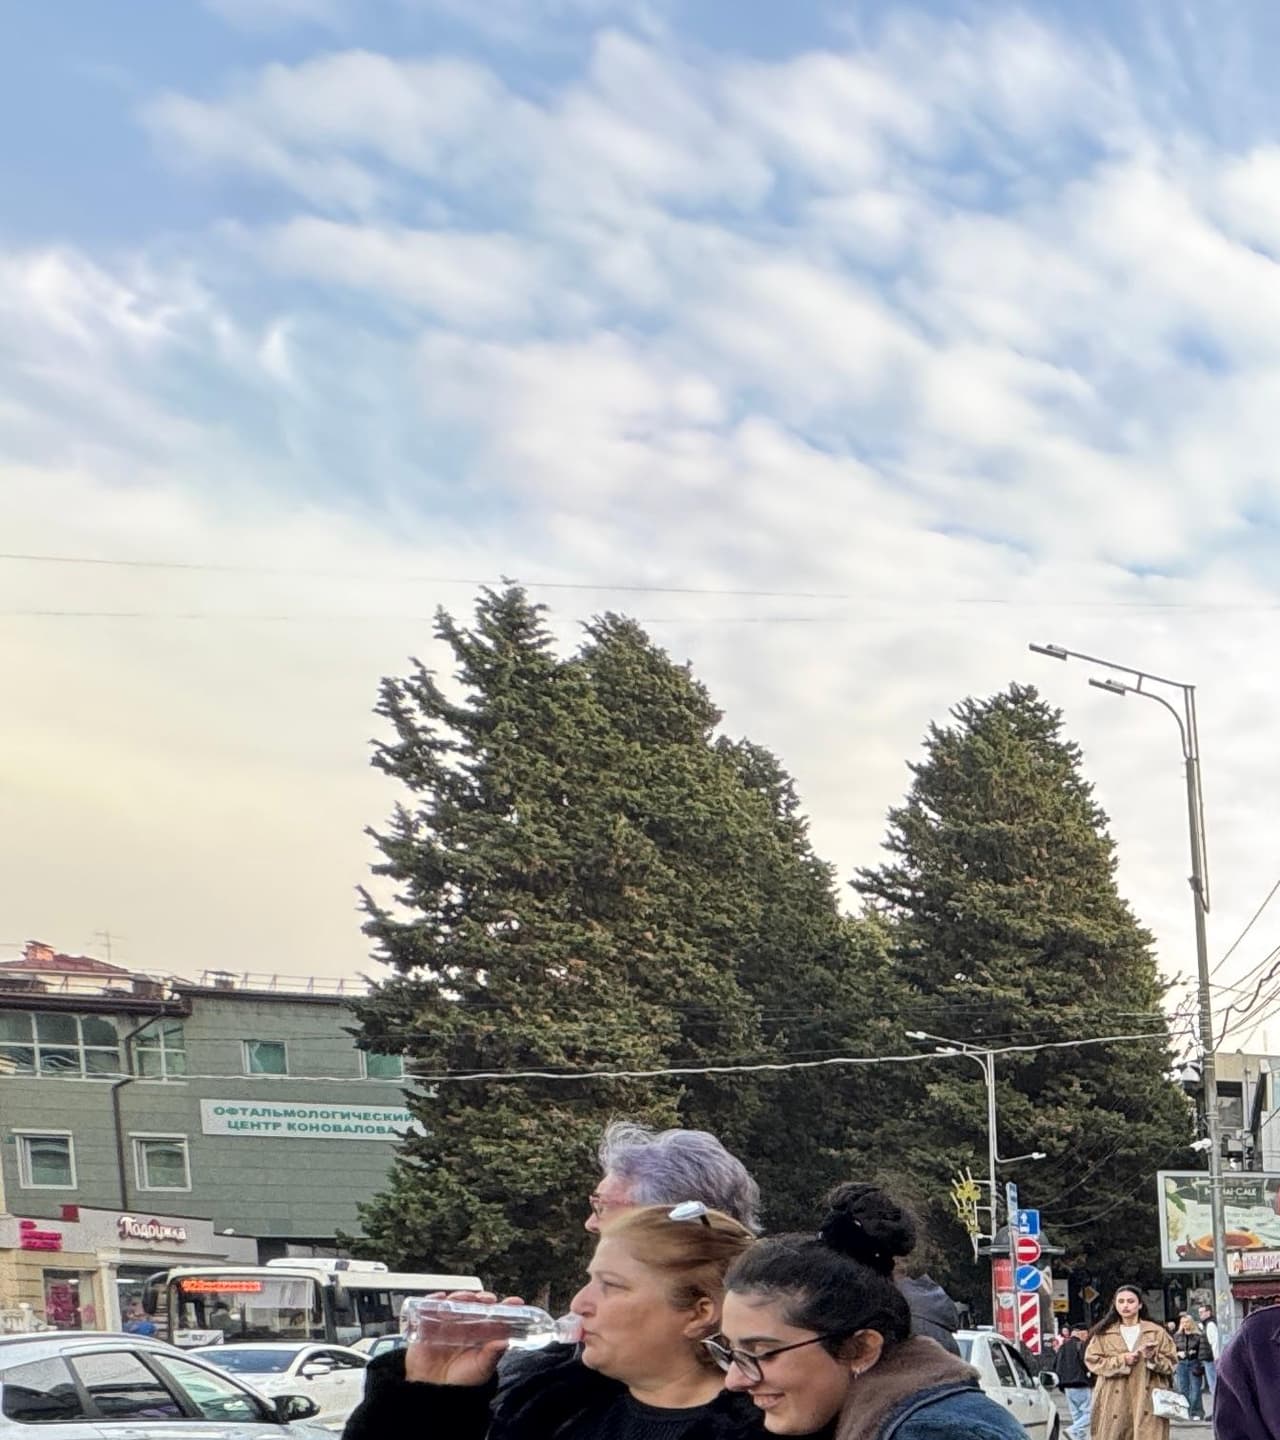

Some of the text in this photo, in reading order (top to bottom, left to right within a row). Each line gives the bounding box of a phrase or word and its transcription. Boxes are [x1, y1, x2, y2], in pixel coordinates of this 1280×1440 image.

[213, 1105, 415, 1123] ОФТАЛЬМОЛОГИЧЕСКИЙ
[227, 1119, 395, 1136] ЦЕНТР КОНОВАЛОВА
